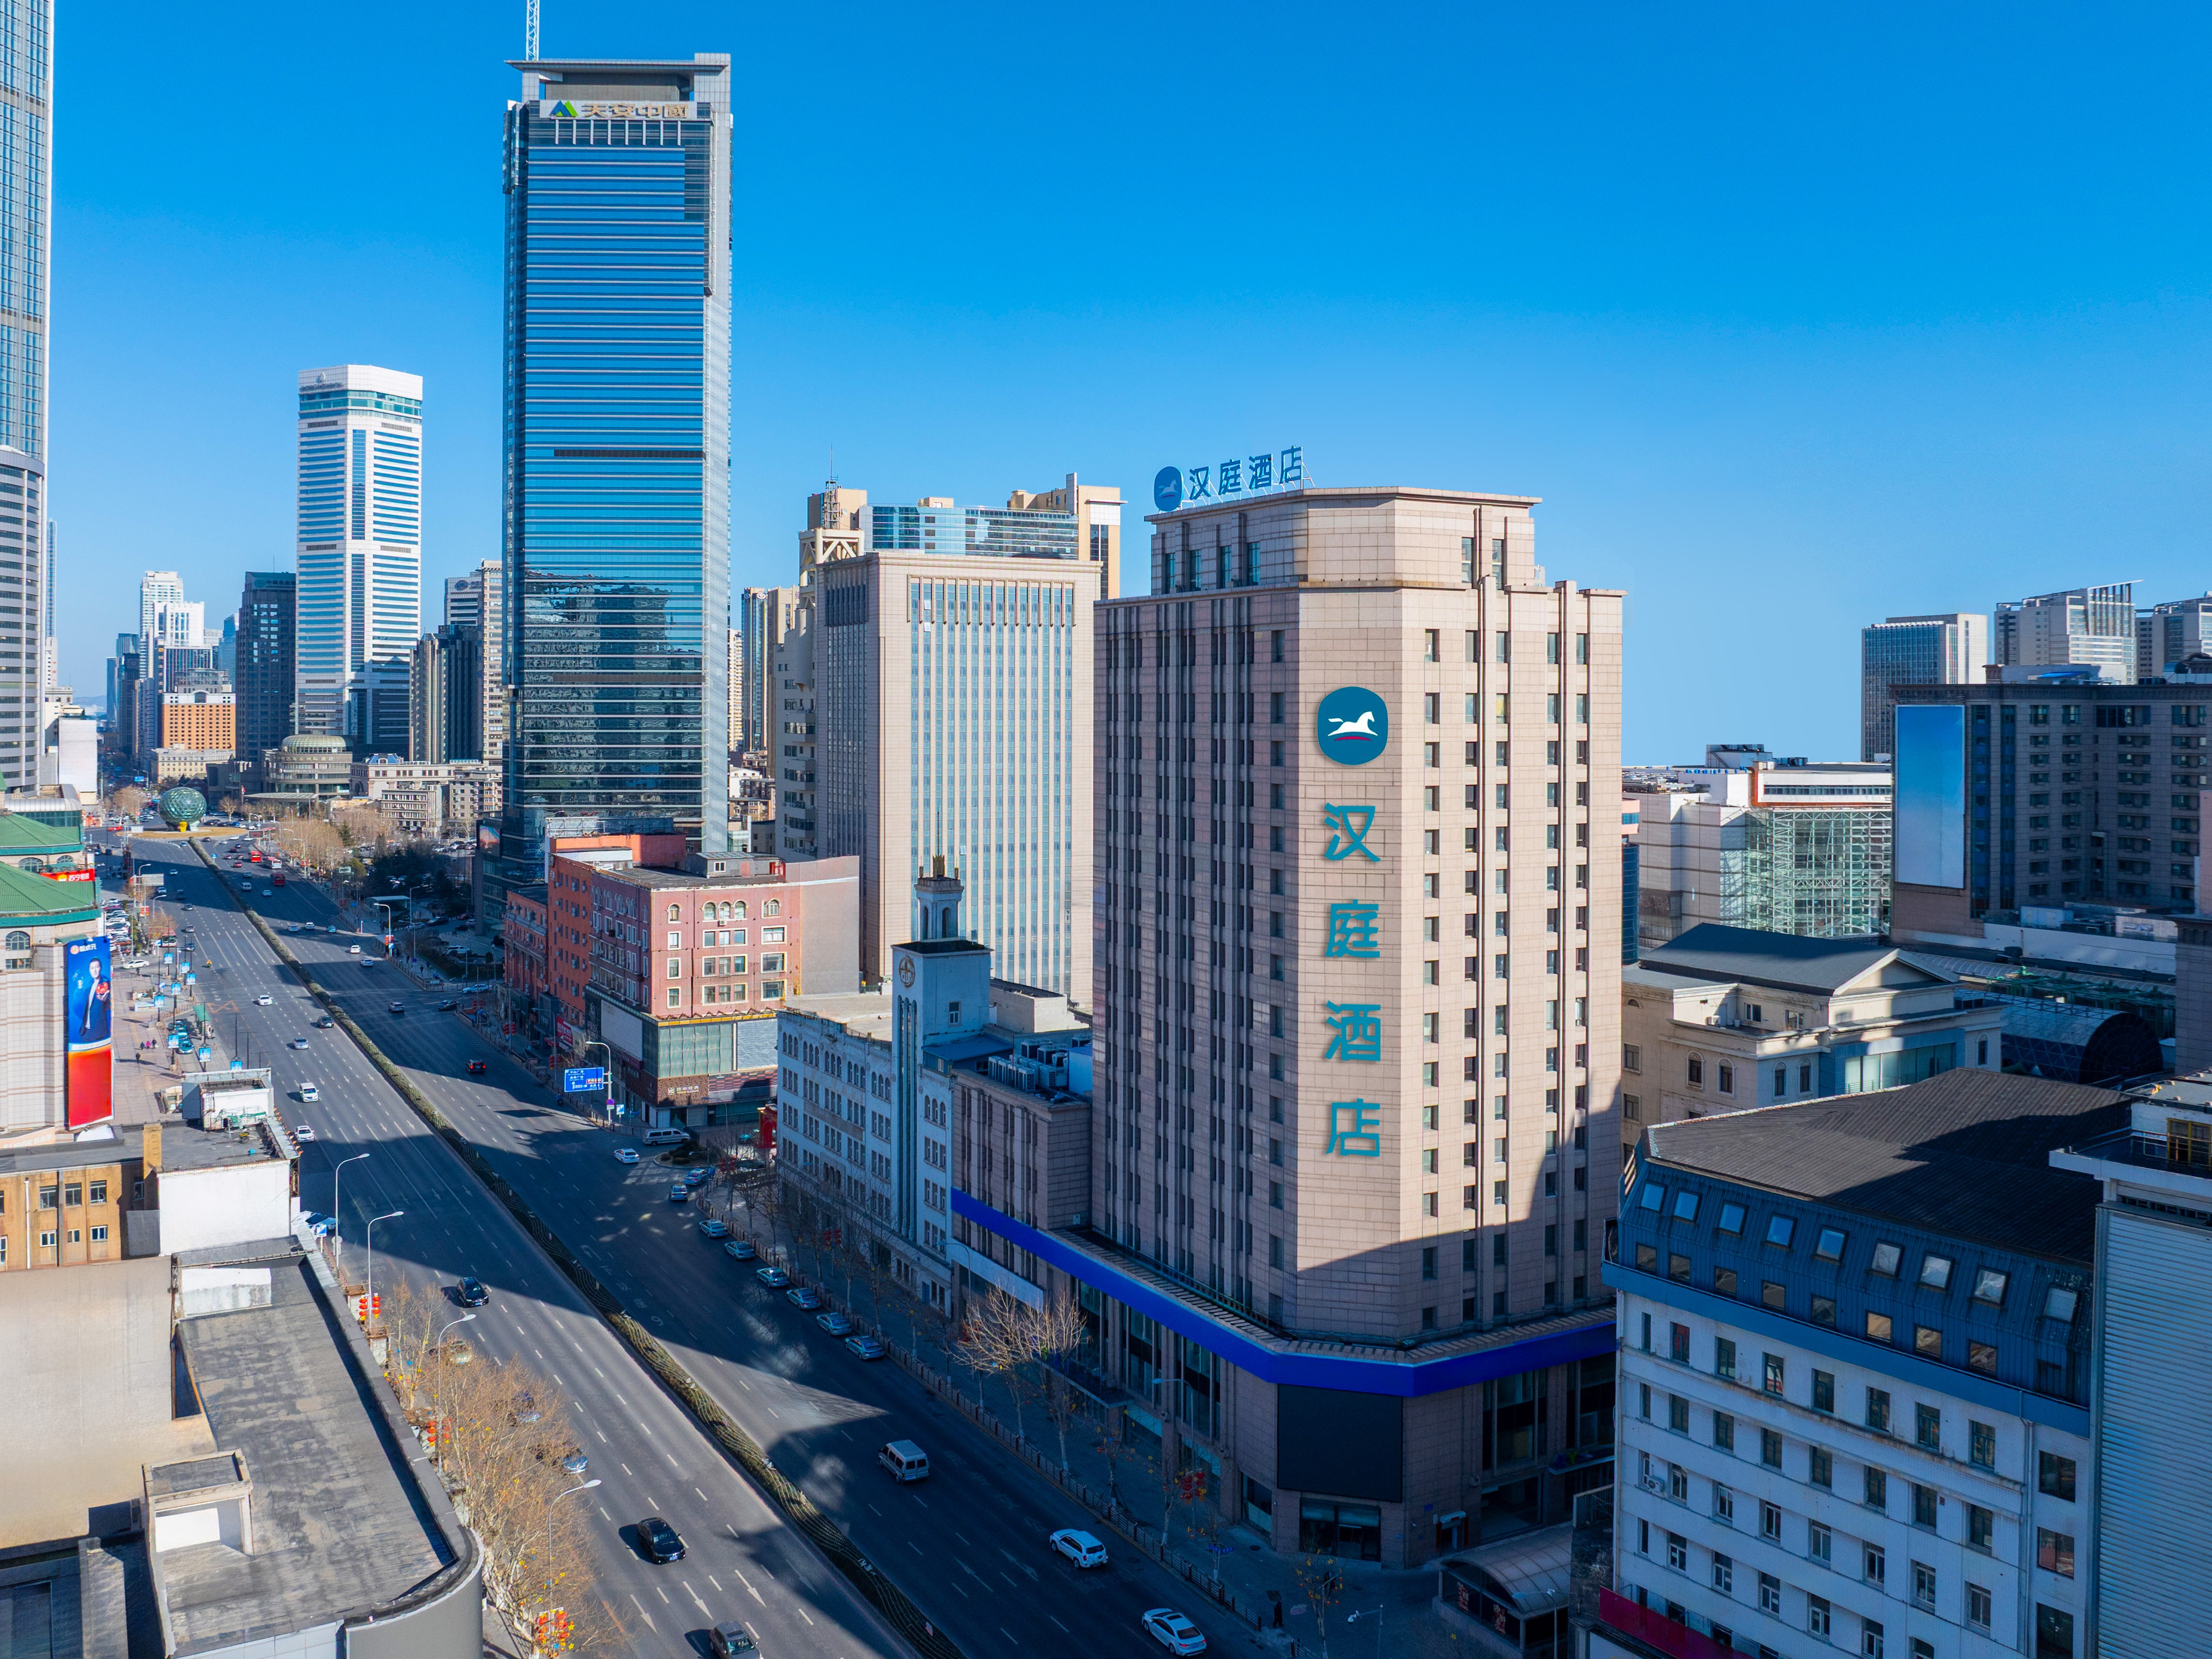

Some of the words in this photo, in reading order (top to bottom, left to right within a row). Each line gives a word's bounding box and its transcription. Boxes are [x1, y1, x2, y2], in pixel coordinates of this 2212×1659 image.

[581, 103, 688, 118] 天安中國
[1189, 445, 1304, 500] 汉庭酒店
[1324, 802, 1381, 1158] 汉庭酒店
